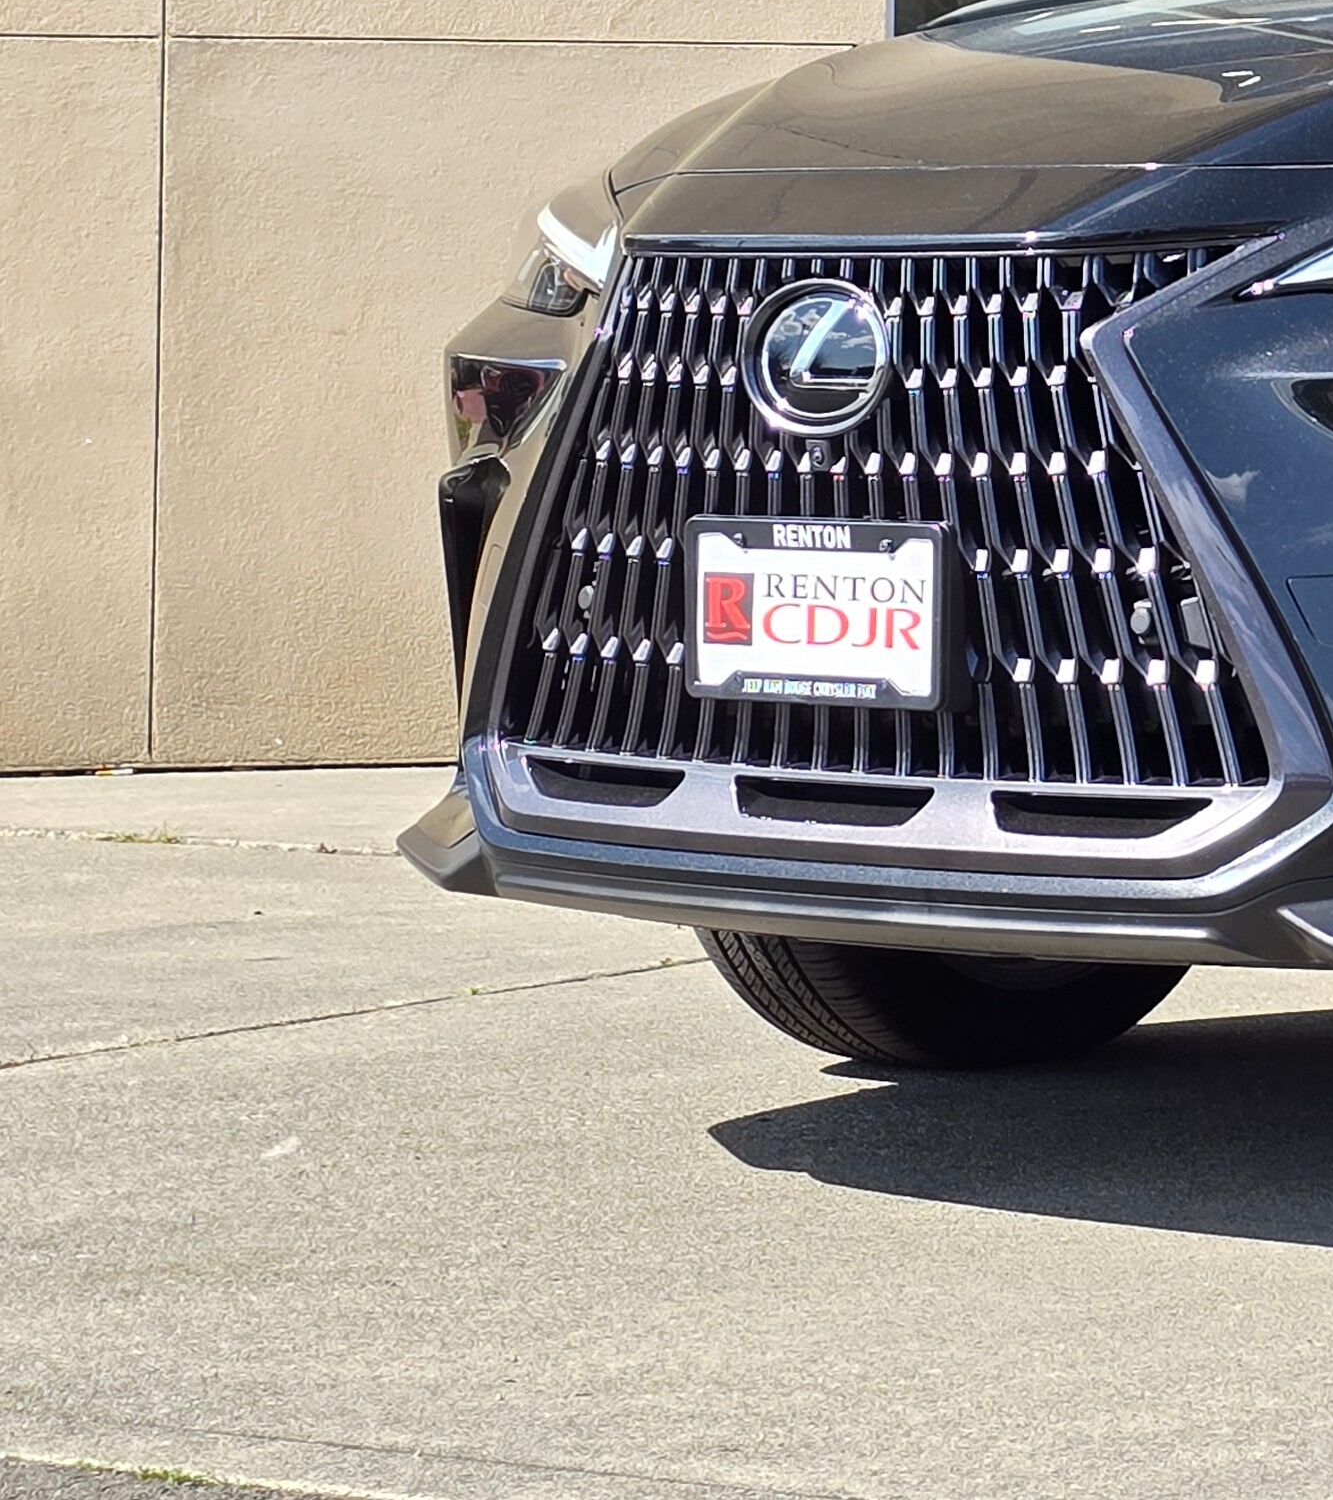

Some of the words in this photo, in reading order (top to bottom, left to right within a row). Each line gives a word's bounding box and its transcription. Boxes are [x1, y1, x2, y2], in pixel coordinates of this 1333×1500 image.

[772, 523, 852, 549] RENTON
[762, 572, 927, 605] RENTON
[762, 603, 922, 650] CDJR
